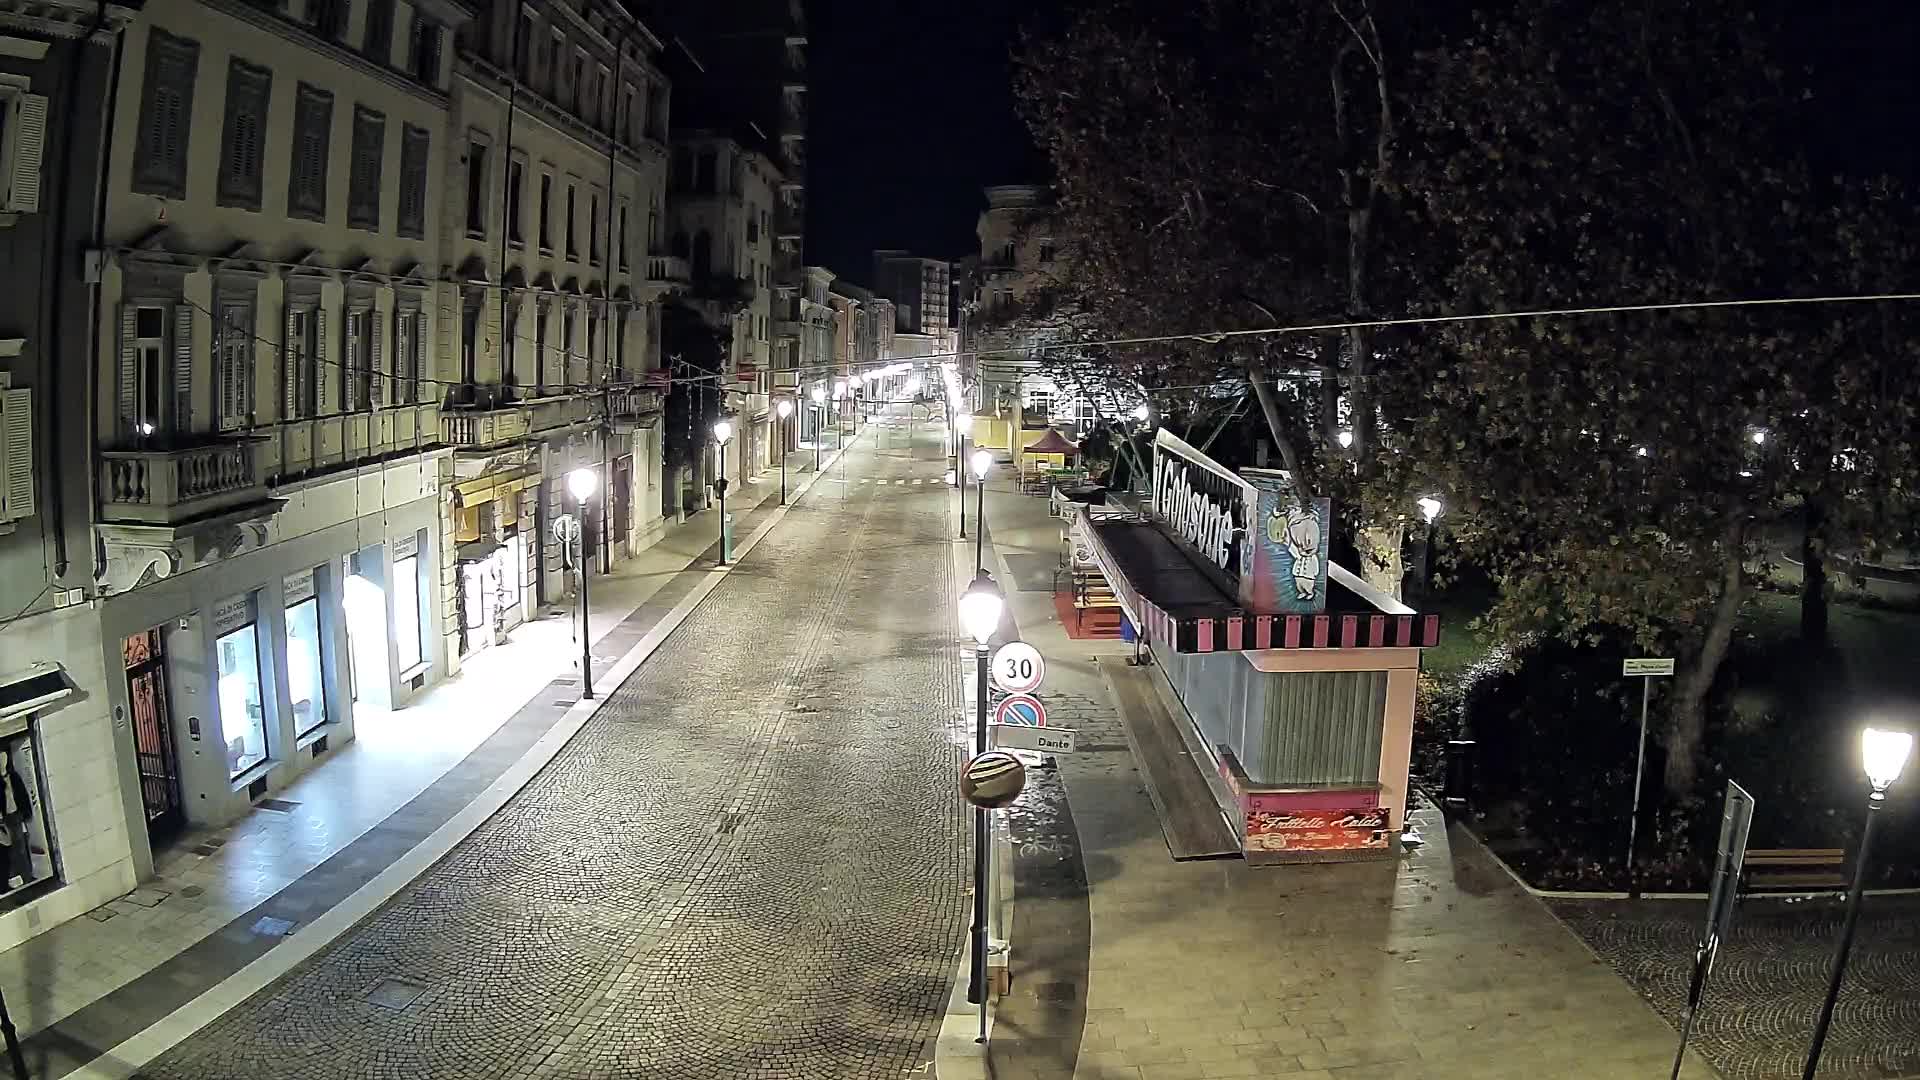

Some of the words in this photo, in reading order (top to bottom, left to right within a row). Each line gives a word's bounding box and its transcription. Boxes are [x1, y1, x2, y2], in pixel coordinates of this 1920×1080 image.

[1162, 457, 1233, 569] Golosone
[1006, 658, 1032, 679] 30
[1038, 737, 1070, 749] Dante
